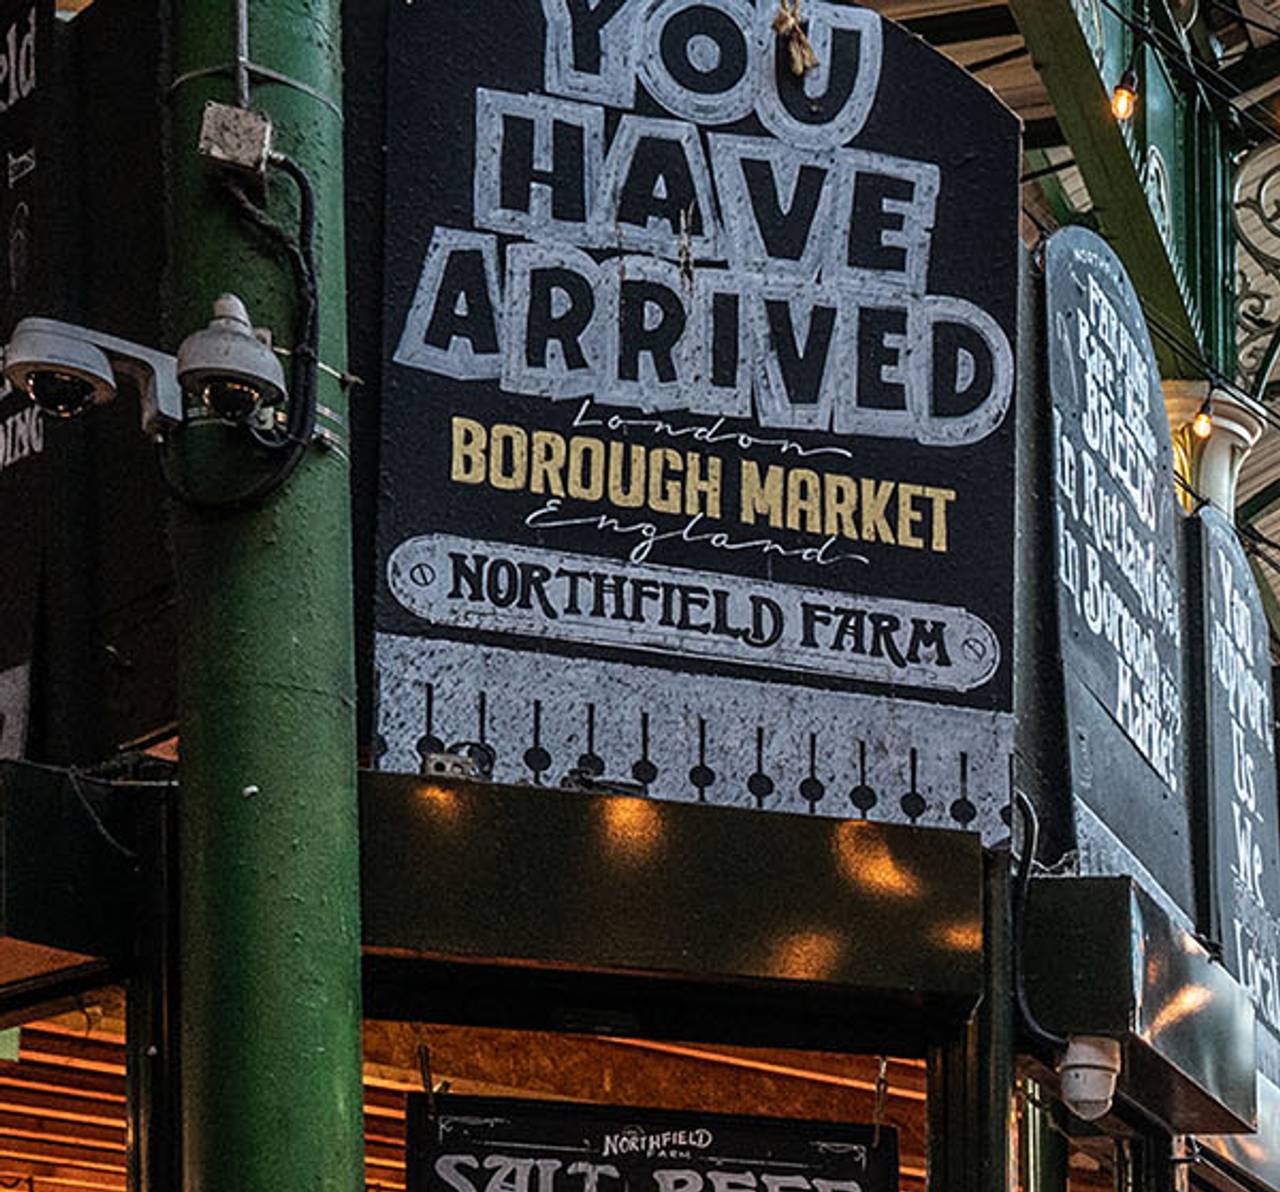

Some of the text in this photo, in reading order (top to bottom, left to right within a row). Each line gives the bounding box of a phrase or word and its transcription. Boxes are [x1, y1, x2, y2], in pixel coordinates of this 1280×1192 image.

[544, 0, 883, 148] YOU
[475, 86, 940, 300] HAVE
[394, 226, 1014, 446] ARRIVED
[451, 417, 956, 552] BOROUGH MARKET
[573, 399, 852, 458] London
[526, 499, 868, 563] England
[447, 552, 953, 668] NORTHFIELD FARM
[602, 1128, 713, 1156] NORTHFIELD
